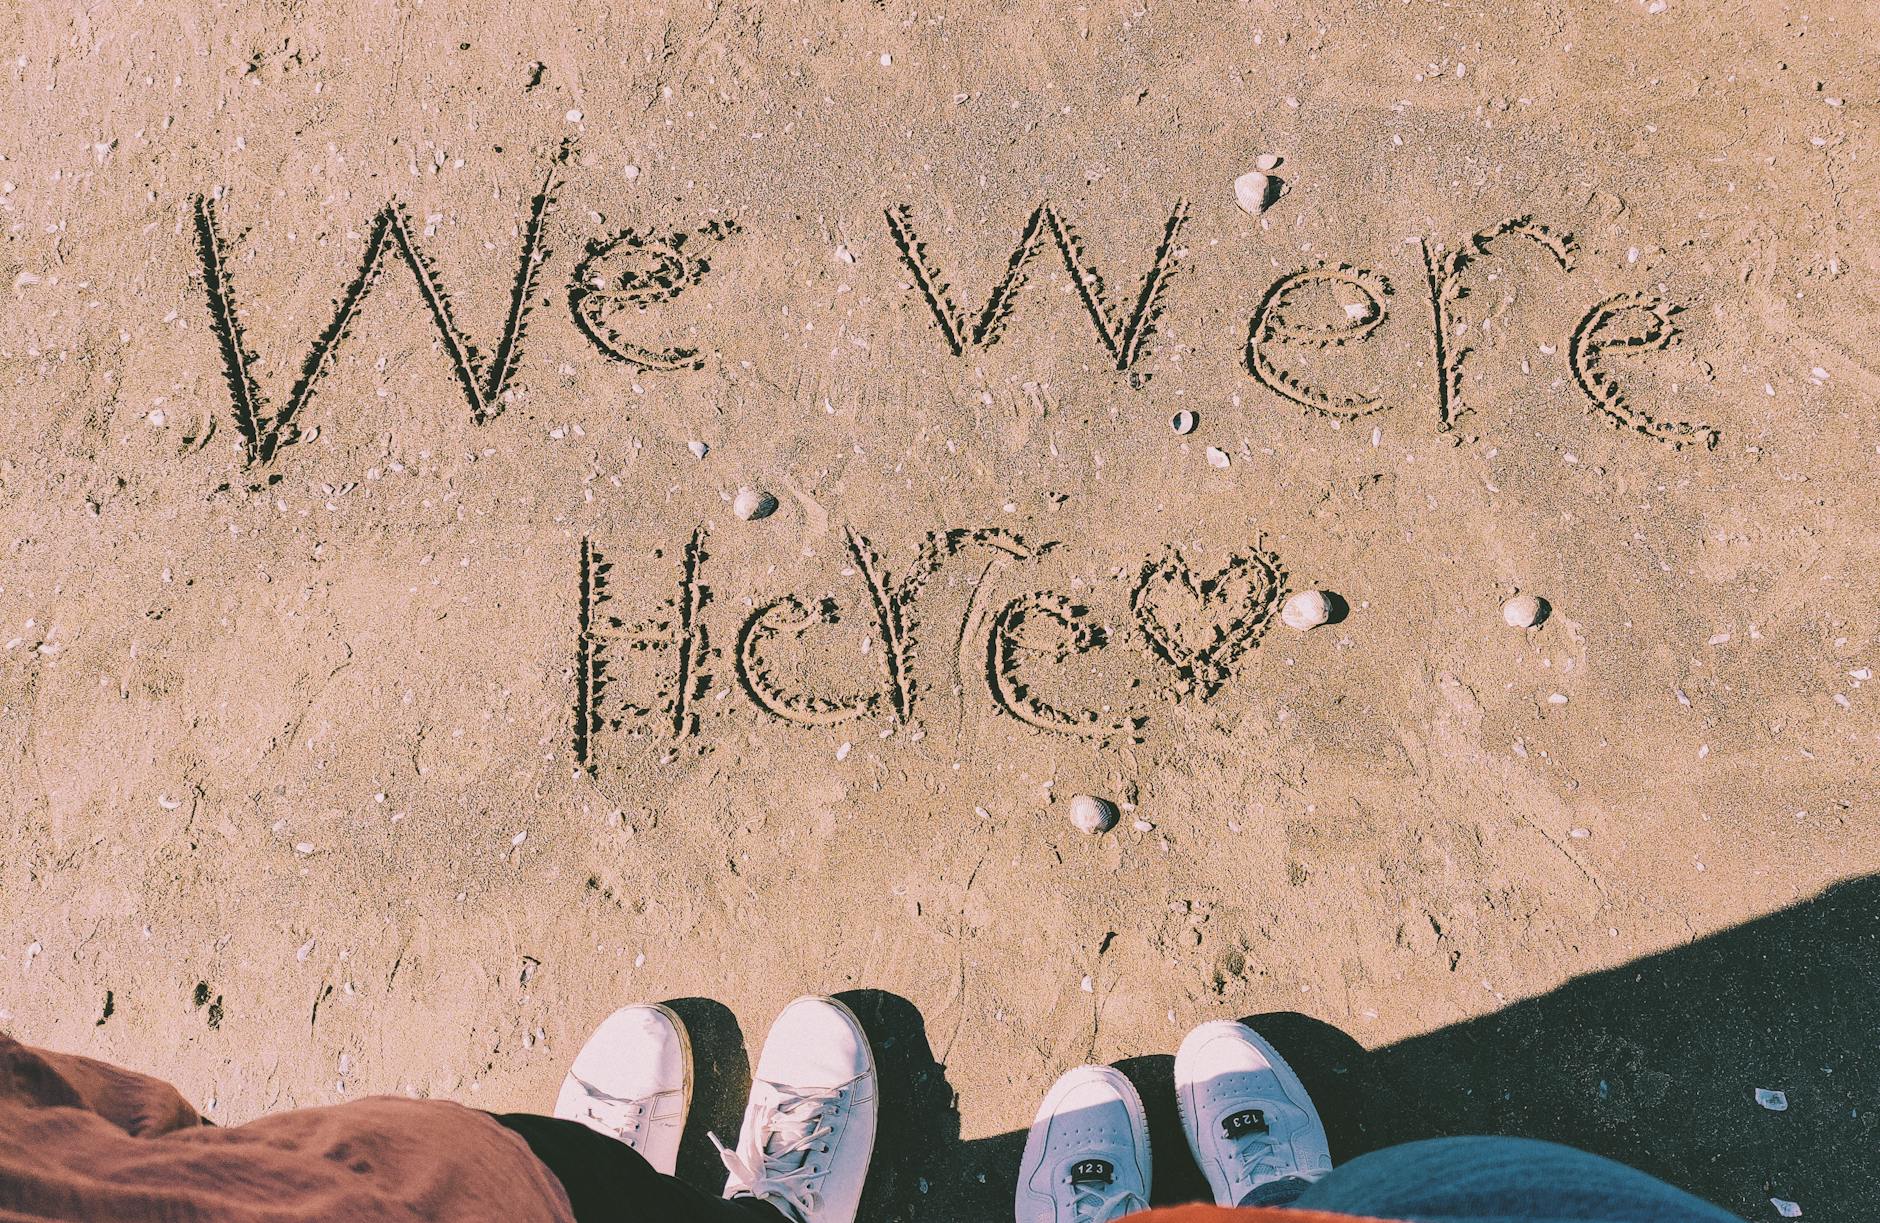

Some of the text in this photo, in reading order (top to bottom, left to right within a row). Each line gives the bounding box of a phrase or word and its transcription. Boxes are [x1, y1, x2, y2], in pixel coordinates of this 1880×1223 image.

[194, 140, 738, 468] We
[572, 524, 1146, 775] Here
[1078, 1163, 1103, 1174] 123
[1233, 1114, 1258, 1127] 123
